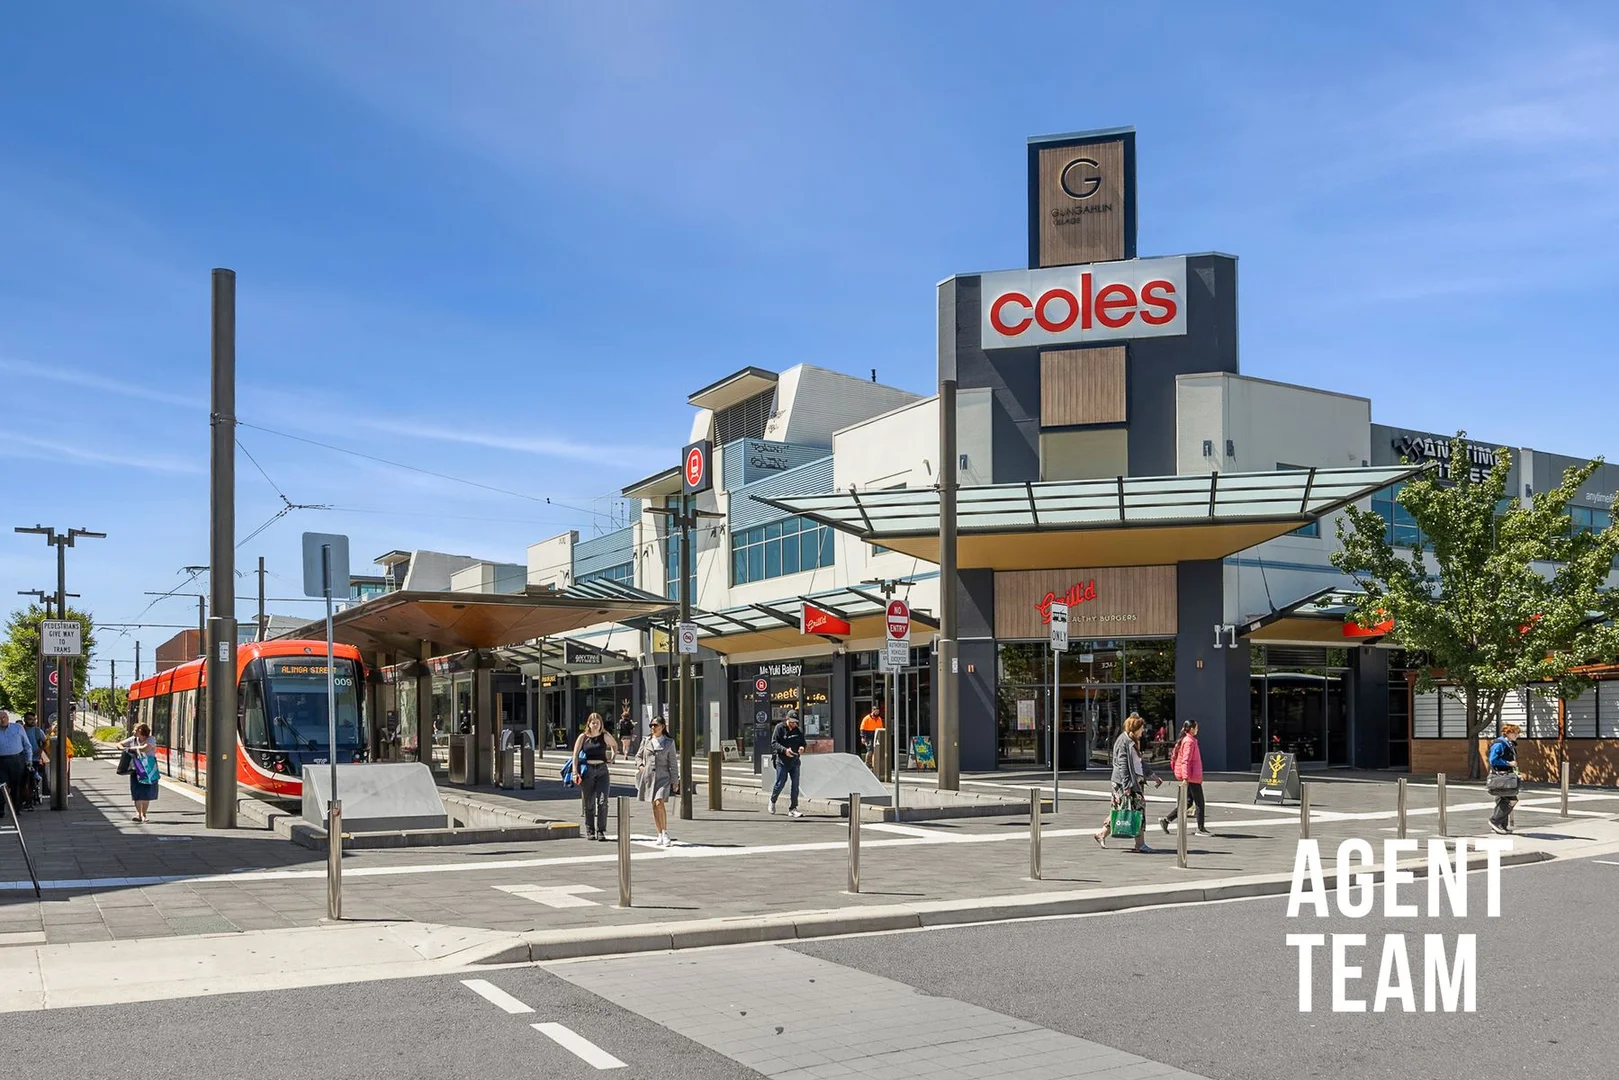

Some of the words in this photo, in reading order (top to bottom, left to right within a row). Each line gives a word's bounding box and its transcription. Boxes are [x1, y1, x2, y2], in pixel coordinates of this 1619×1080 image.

[1059, 157, 1102, 200] G
[1051, 204, 1113, 217] GUNGAHLIN
[1053, 218, 1081, 227] VILLAGE
[990, 272, 1177, 336] coles
[1423, 437, 1501, 466] ANTIM
[1436, 460, 1493, 483] ITES
[1034, 578, 1097, 625] Grill'd
[893, 606, 902, 615] NO
[805, 615, 828, 633] Grill'd
[1067, 614, 1097, 623] EALTHY
[1100, 614, 1137, 623] BURGERS
[44, 622, 80, 630] PEDESTRIANS
[890, 624, 907, 634] ENTRY
[49, 630, 61, 638] GIVE
[63, 630, 74, 638] WAY
[1052, 629, 1067, 642] ONLY
[59, 638, 66, 646] TO
[281, 666, 309, 674] ALINGA
[310, 666, 338, 674] STRET
[768, 665, 781, 676] Yuki
[782, 664, 802, 677] Bakery
[334, 678, 353, 687] 009
